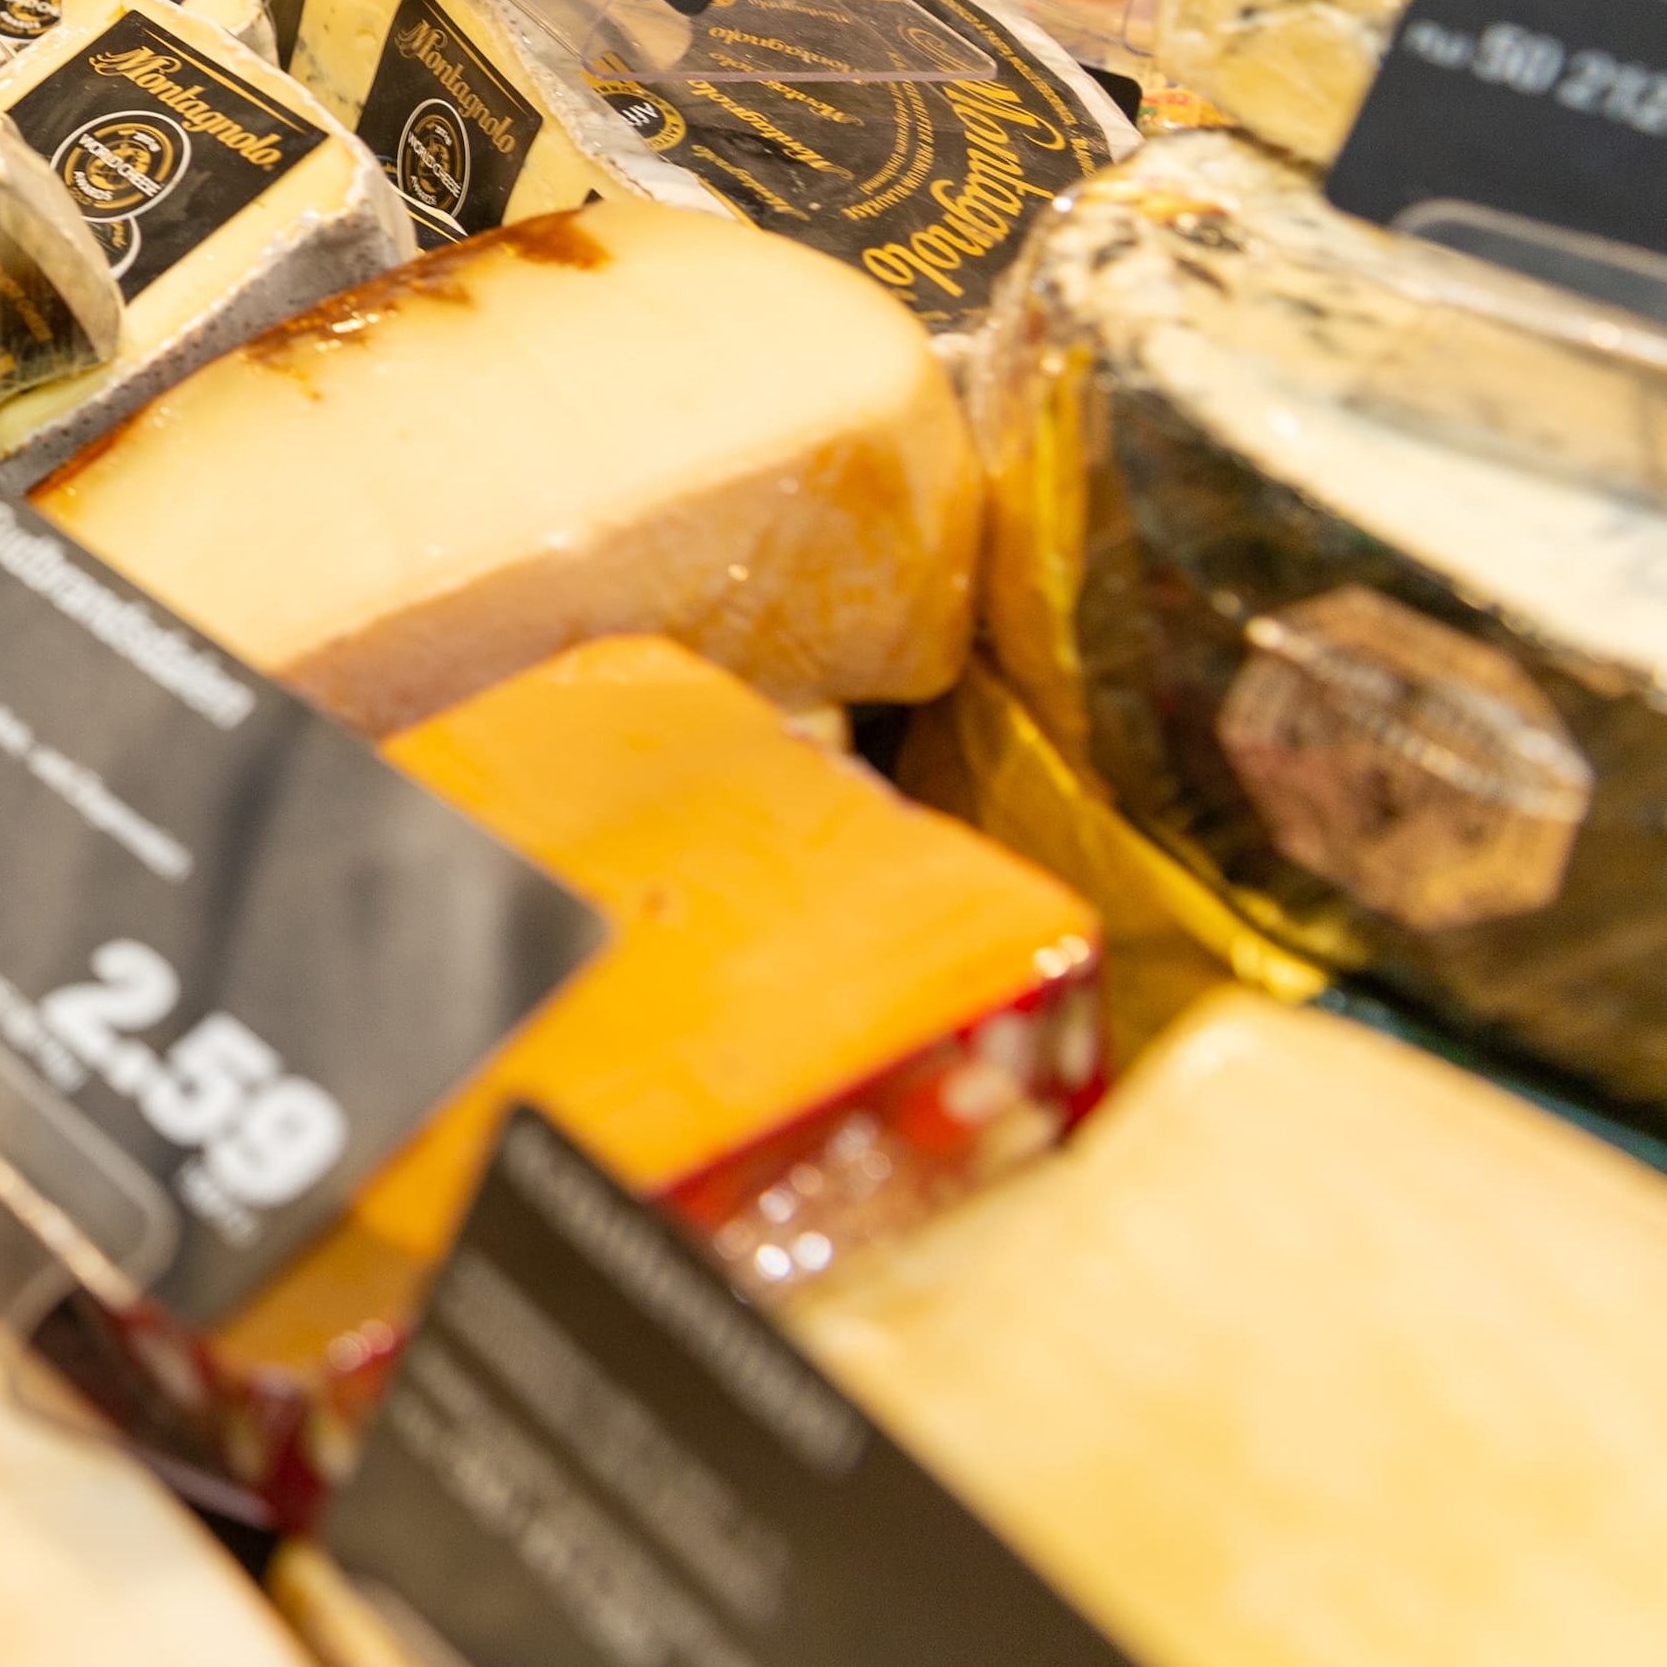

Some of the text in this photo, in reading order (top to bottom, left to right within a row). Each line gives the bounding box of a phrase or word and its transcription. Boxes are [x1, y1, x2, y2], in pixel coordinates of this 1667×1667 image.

[89, 45, 283, 167] Montagnolo
[394, 20, 516, 154] Montagnolo
[407, 131, 437, 168] WORLD
[79, 133, 163, 197] WORLD CHEESE
[863, 76, 1065, 297] Montagnolo
[38, 936, 348, 1207] 2.59
